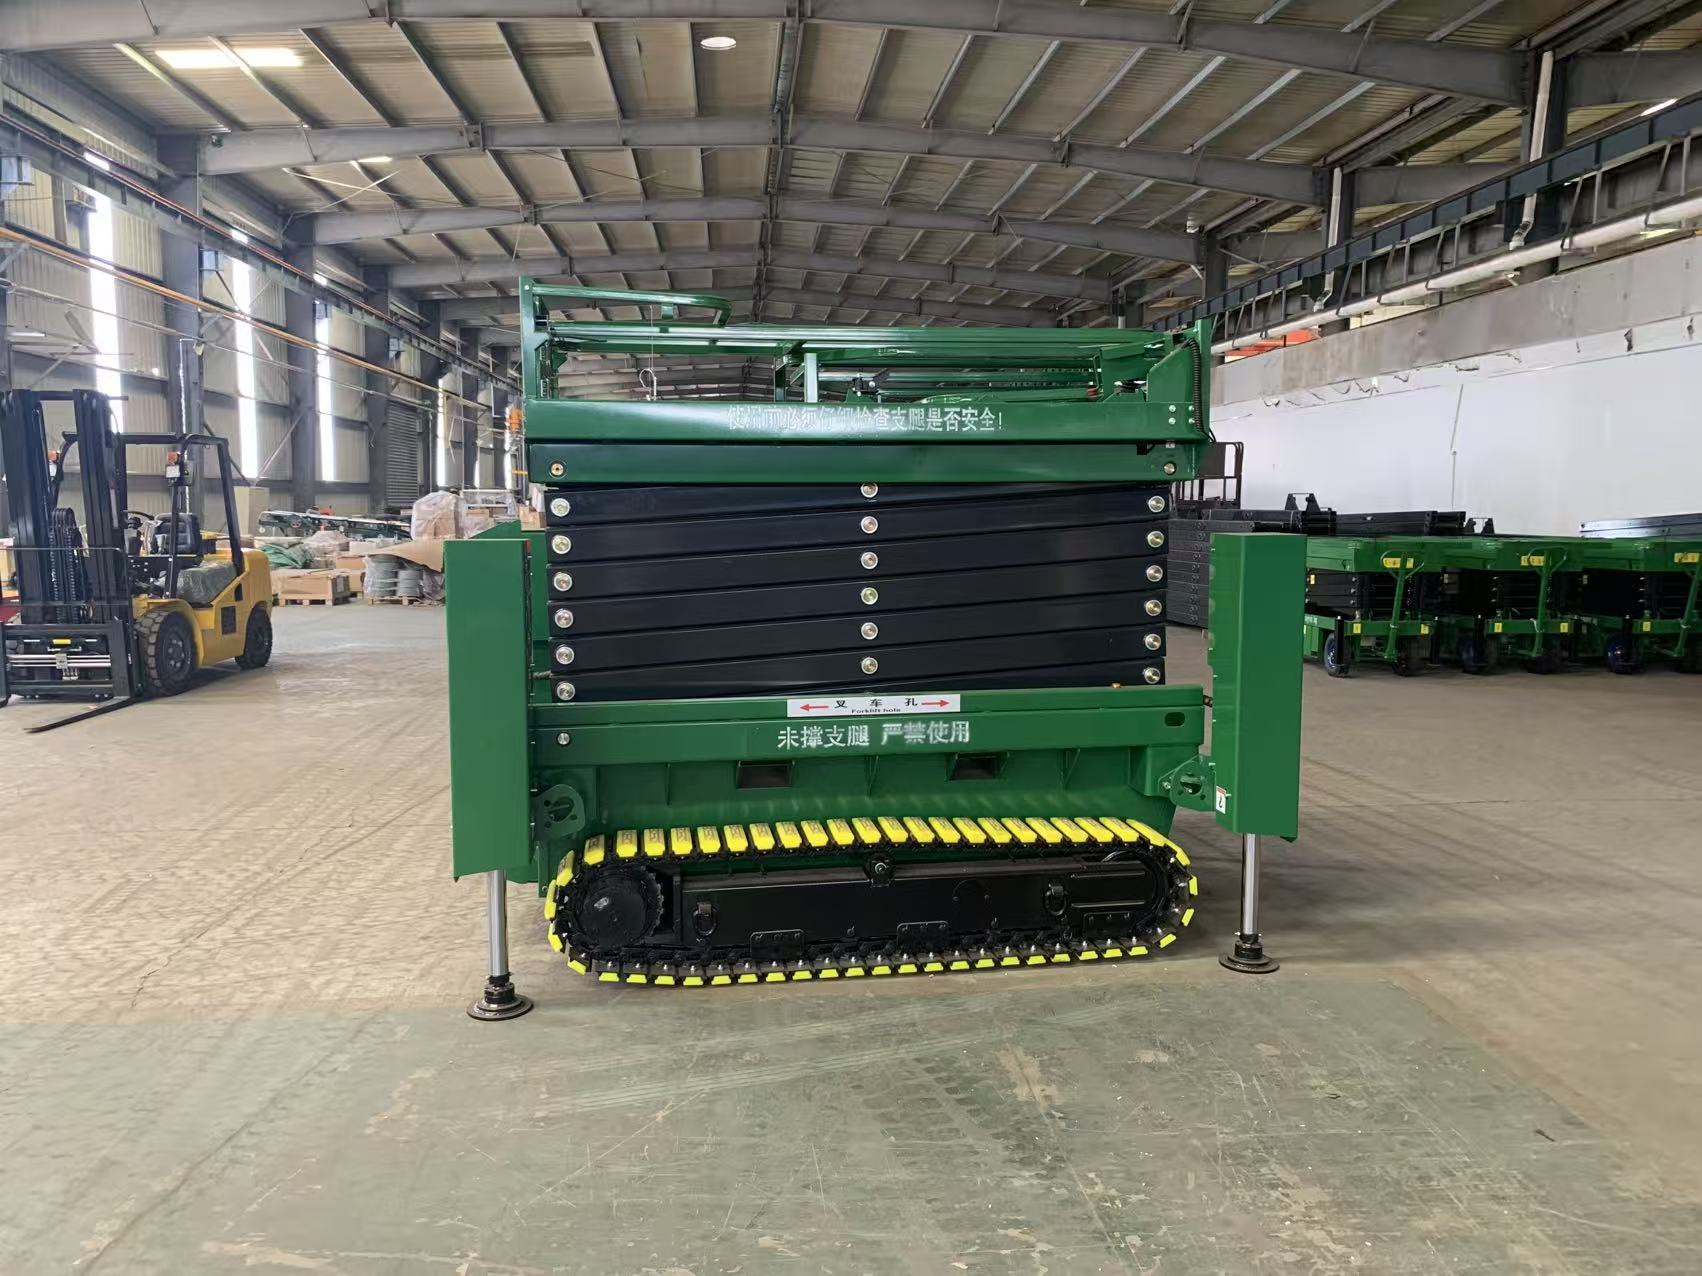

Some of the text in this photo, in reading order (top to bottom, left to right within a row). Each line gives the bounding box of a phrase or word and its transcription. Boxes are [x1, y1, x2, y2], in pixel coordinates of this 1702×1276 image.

[777, 720, 970, 750] 未撑支腿 严禁使用
